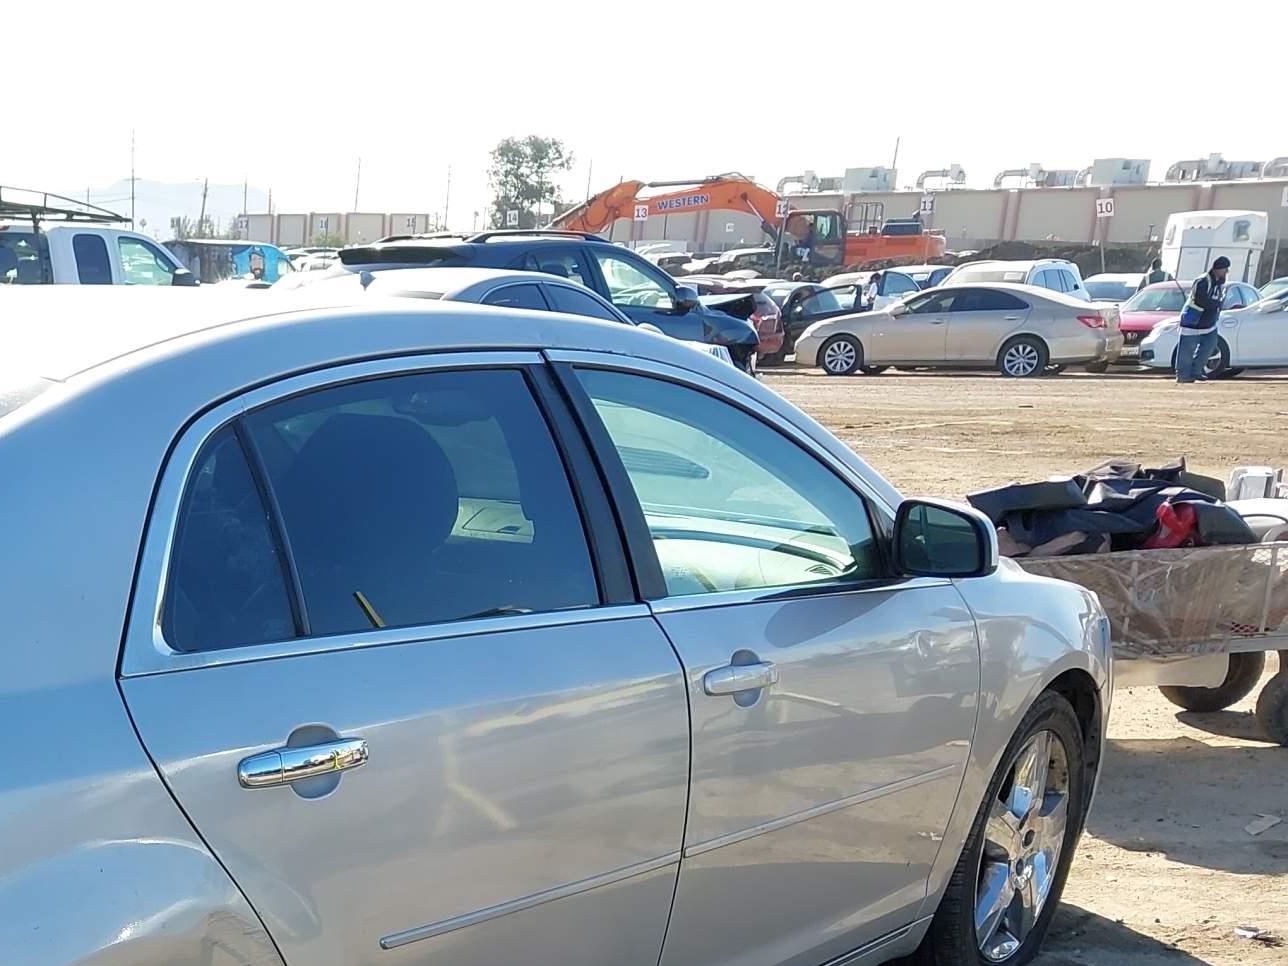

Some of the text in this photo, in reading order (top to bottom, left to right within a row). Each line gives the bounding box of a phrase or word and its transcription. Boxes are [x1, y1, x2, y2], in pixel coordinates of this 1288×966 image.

[657, 194, 709, 210] WESTERN
[921, 200, 934, 211] 11
[1097, 201, 1113, 214] 10
[507, 212, 517, 223] 14
[635, 208, 648, 218] 13
